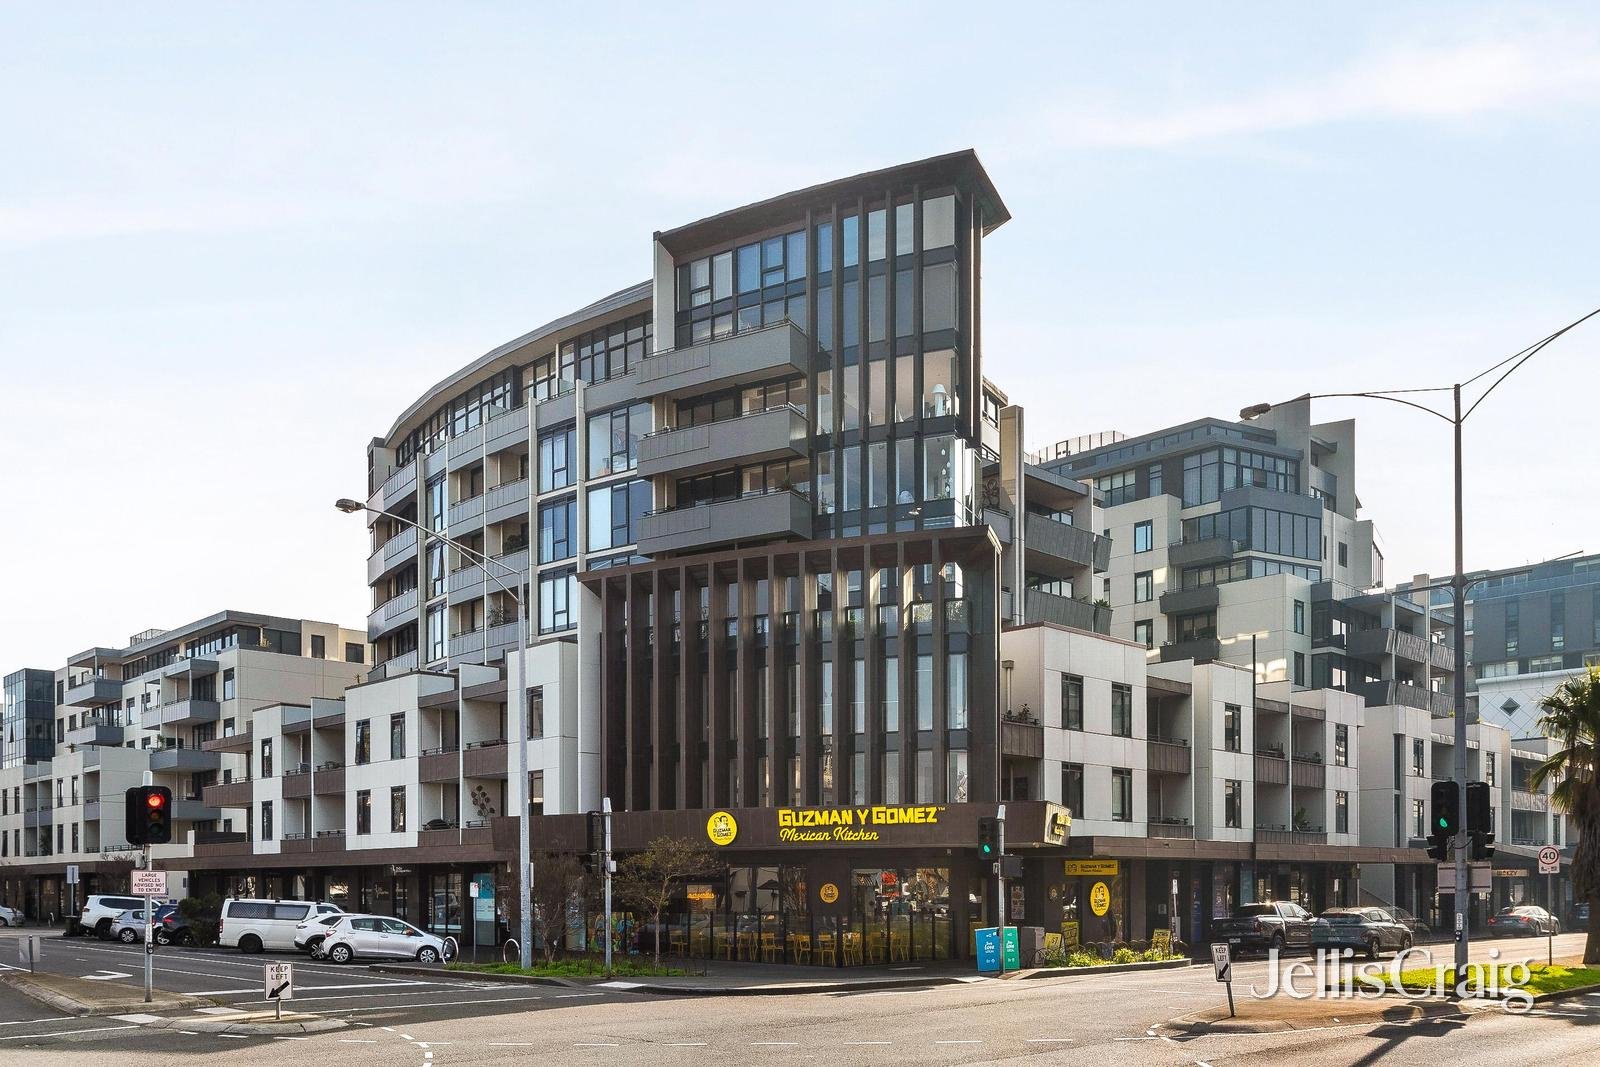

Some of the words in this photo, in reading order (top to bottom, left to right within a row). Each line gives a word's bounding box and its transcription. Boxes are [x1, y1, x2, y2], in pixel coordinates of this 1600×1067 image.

[778, 809, 853, 827] GUZMAN
[856, 808, 869, 825] Y
[779, 828, 831, 842] Mexican
[833, 826, 879, 841] Kitchen
[1541, 851, 1556, 860] 40
